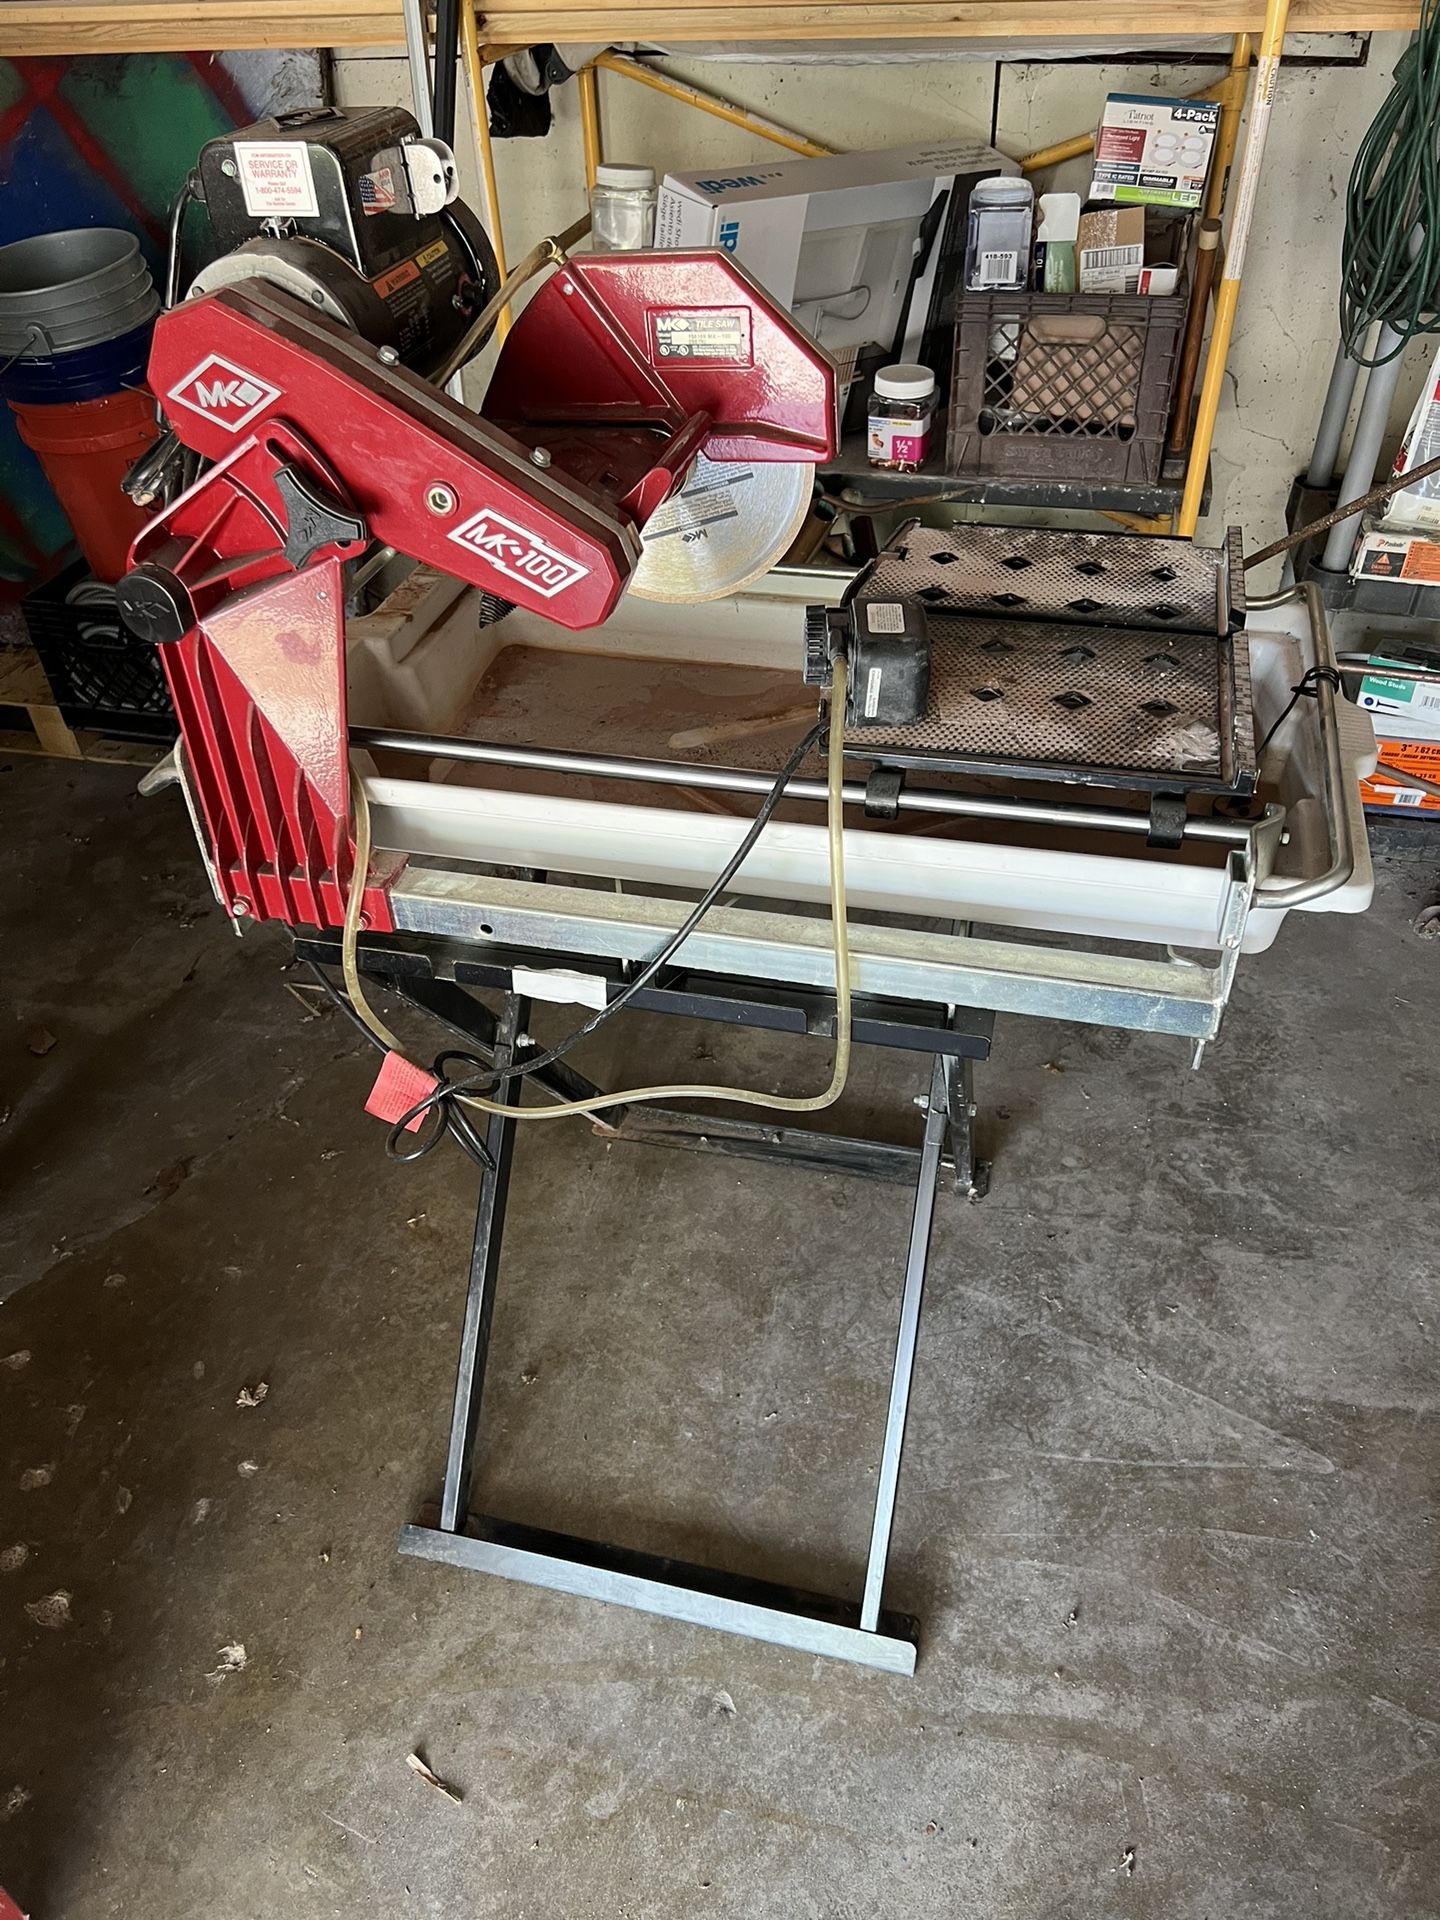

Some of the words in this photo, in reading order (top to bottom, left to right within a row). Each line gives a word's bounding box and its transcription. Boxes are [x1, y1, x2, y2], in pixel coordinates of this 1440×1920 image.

[1266, 68, 1276, 106] CAUTION
[1174, 108, 1216, 123] 4-Pack
[248, 160, 283, 169] SERVICE
[285, 160, 298, 169] OR
[252, 169, 297, 178] WARRANTY
[695, 176, 767, 194] wedi
[1172, 192, 1199, 203] LED
[696, 320, 713, 329] TILE
[715, 320, 735, 329] SAW
[194, 380, 247, 408] MK
[1369, 676, 1387, 686] Wood
[1388, 681, 1406, 690] Studs
